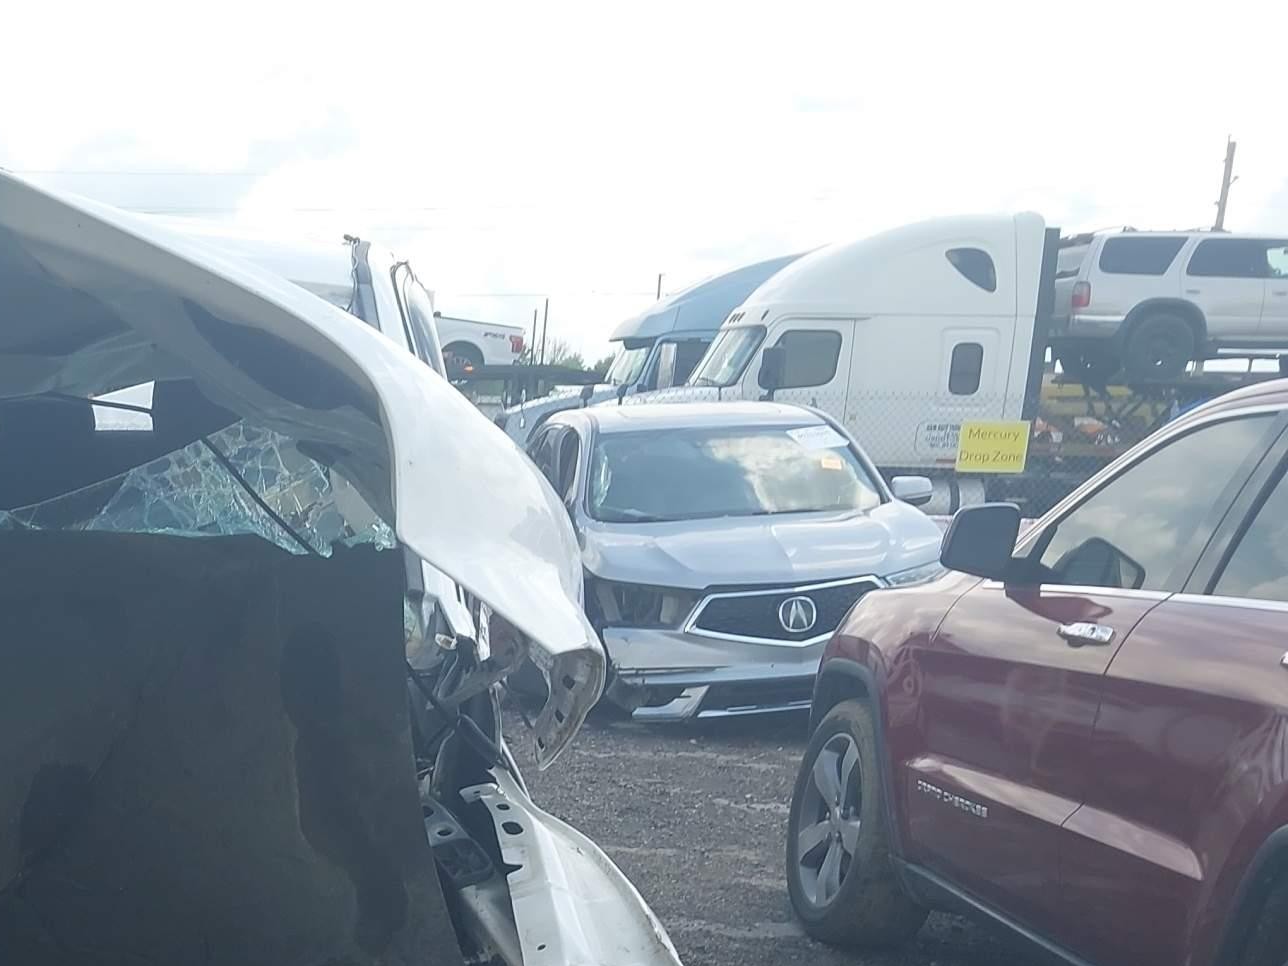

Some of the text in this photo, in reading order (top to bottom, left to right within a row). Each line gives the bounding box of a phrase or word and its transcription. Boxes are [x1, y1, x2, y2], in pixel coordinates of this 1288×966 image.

[967, 427, 1020, 442] Mercury
[959, 450, 1022, 464] Drop Zone
